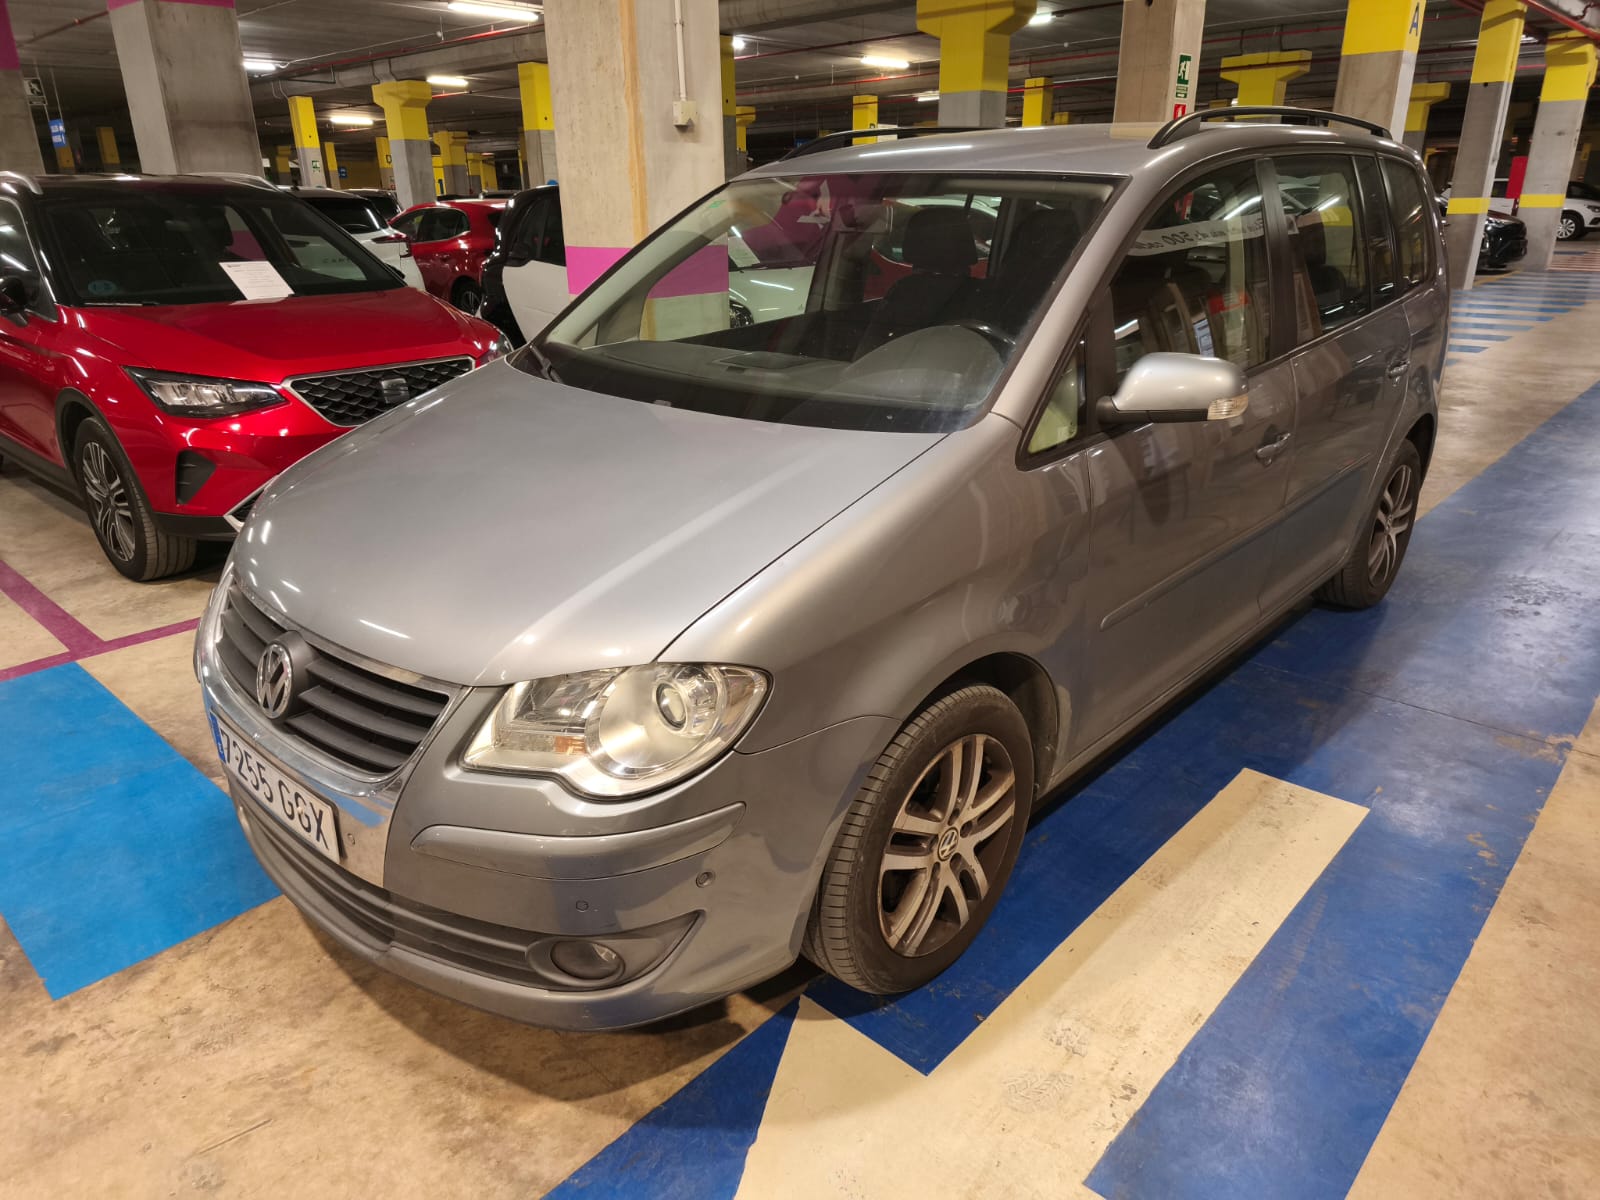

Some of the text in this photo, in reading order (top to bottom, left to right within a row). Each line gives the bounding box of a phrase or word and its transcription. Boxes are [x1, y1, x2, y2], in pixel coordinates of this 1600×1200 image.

[1408, 1, 1420, 37] A
[219, 727, 330, 851] 7255 GGX
